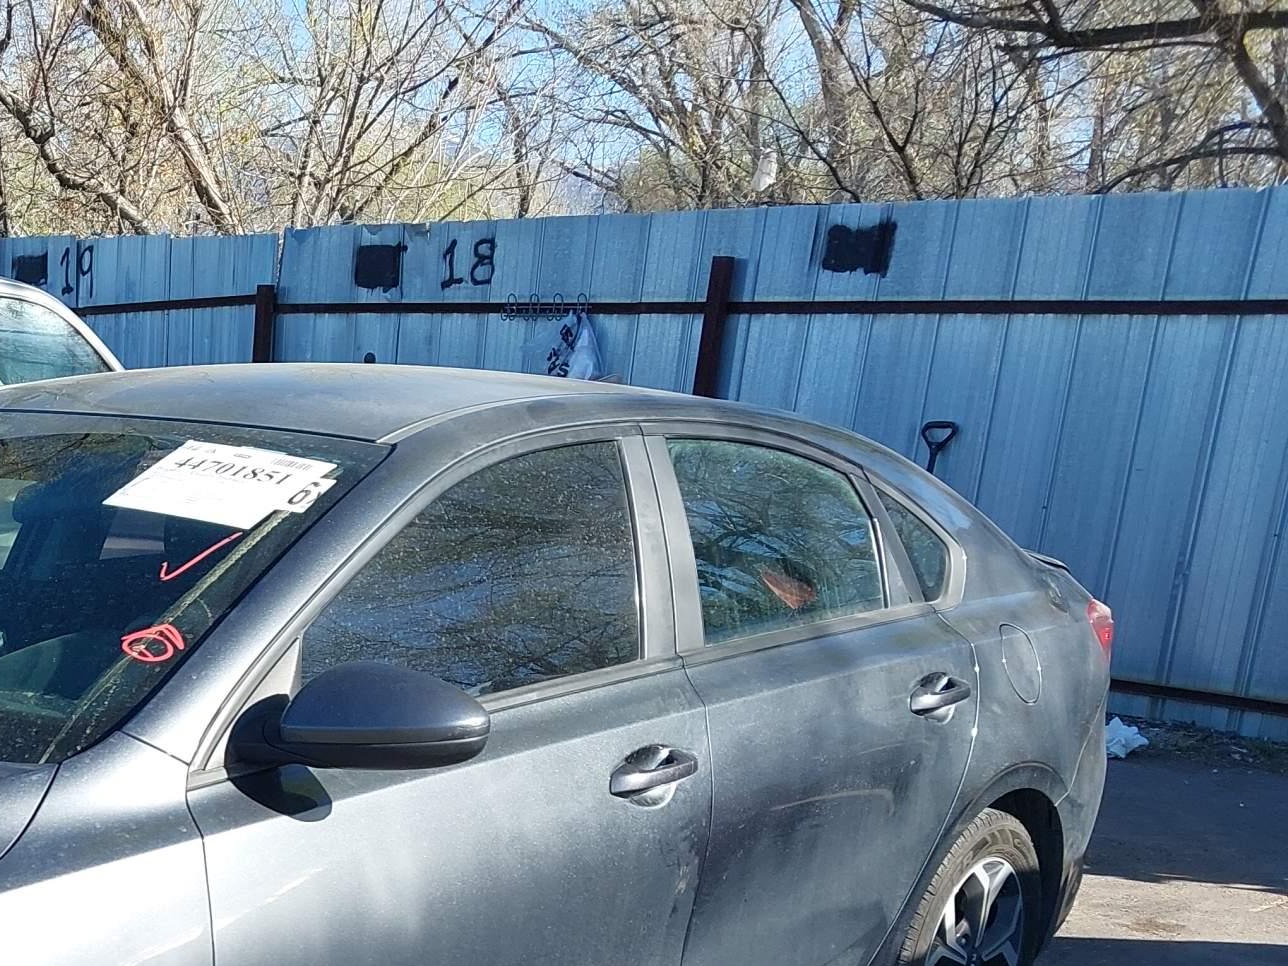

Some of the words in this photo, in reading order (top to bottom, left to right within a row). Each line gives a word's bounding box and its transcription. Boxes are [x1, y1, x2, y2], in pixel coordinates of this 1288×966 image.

[59, 245, 94, 299] 19
[440, 238, 496, 291] 18
[174, 456, 294, 485] 44701851
